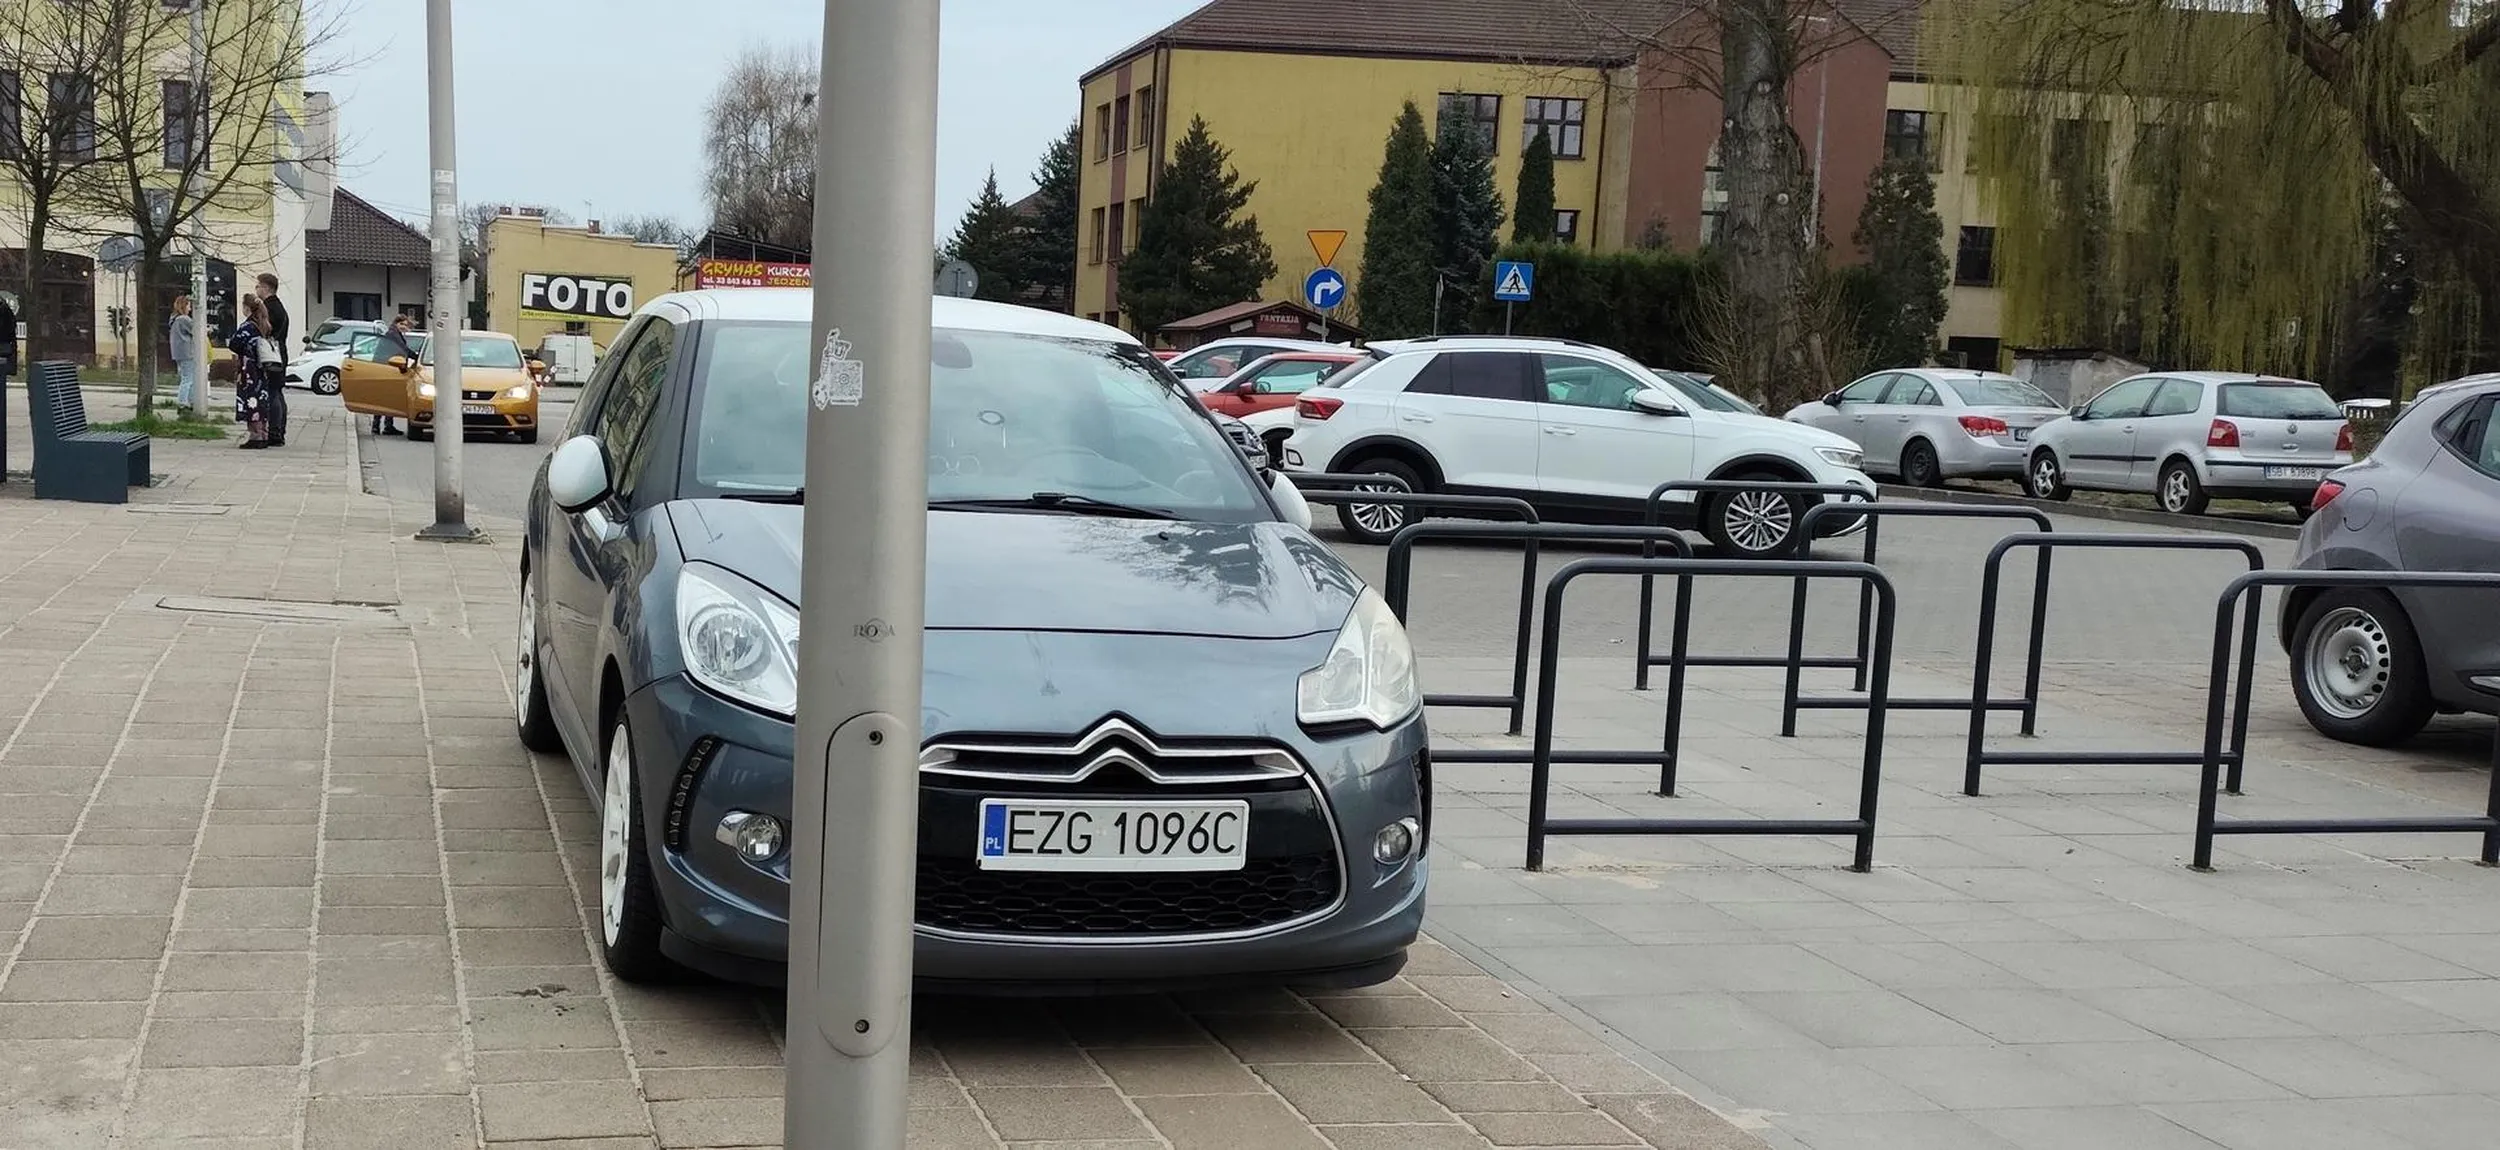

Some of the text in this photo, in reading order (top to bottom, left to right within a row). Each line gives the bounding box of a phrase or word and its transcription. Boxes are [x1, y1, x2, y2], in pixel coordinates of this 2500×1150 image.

[702, 262, 762, 276] GRYMAS
[523, 274, 632, 316] FOTO
[985, 836, 1001, 849] PL
[1008, 810, 1238, 854] EZG 1096C
